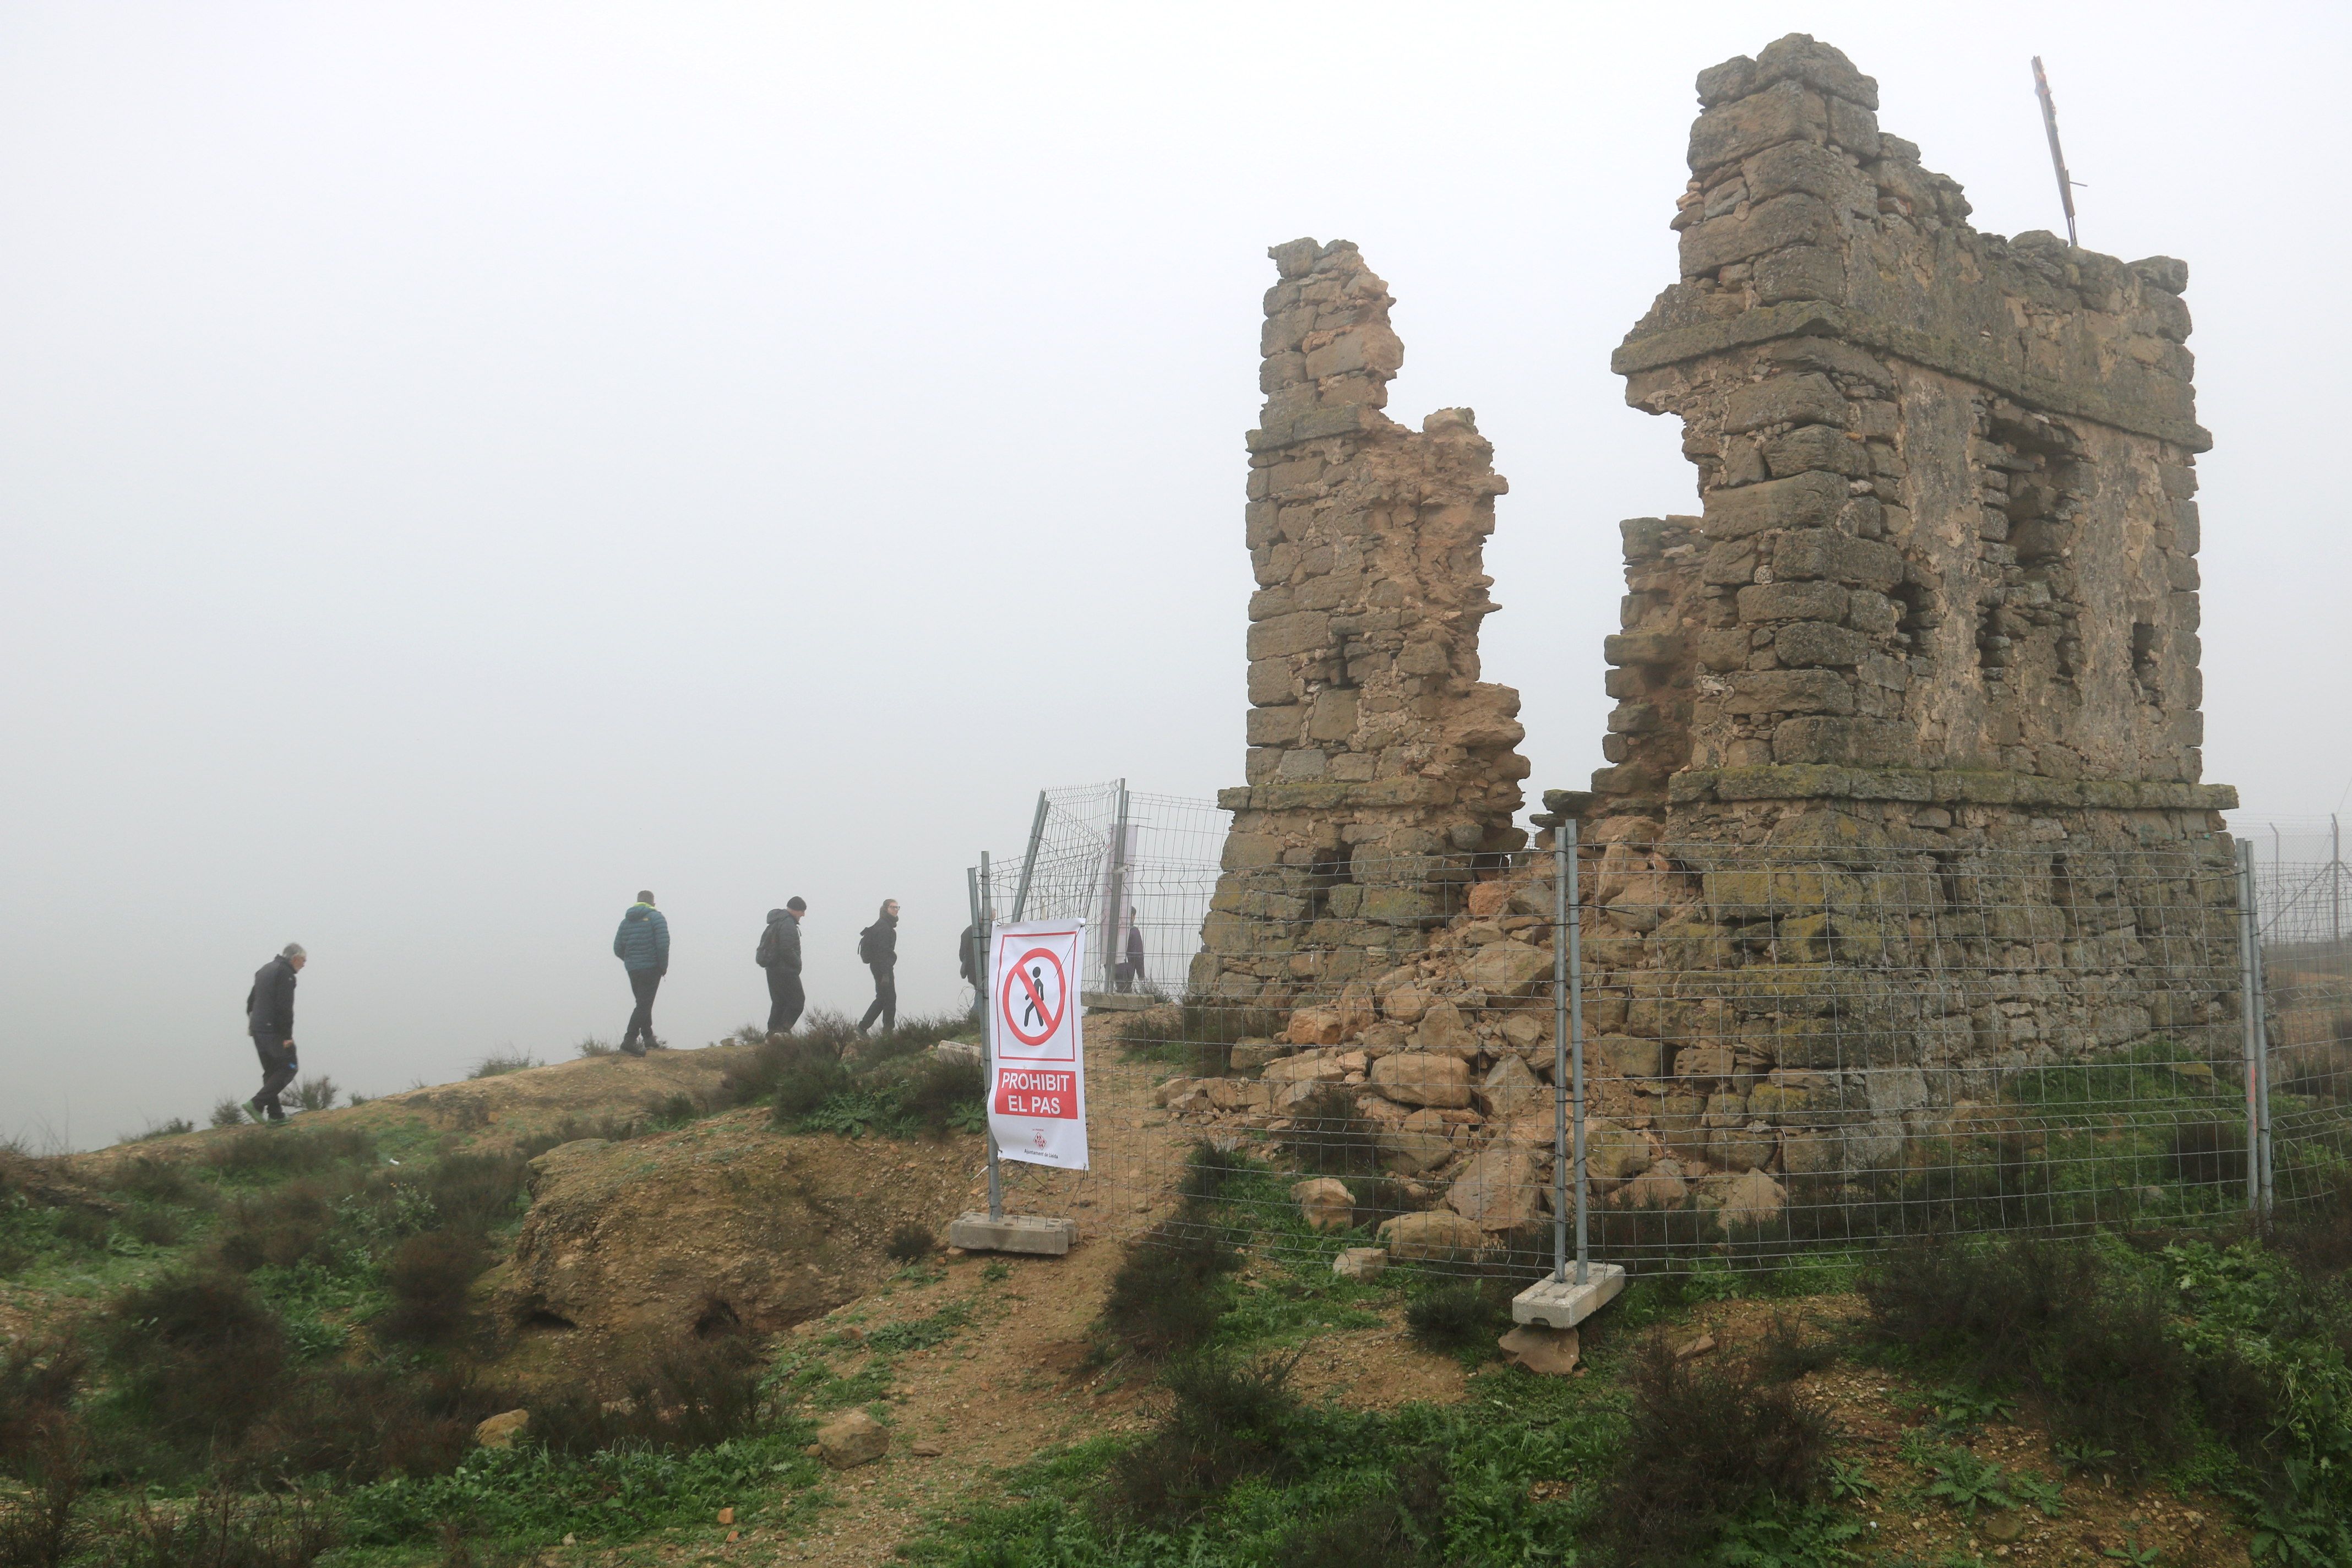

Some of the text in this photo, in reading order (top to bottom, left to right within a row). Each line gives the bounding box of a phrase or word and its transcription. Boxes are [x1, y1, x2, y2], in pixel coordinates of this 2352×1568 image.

[1001, 1072, 1070, 1092] PROHIBIT
[1008, 1095, 1061, 1115] EL PAS
